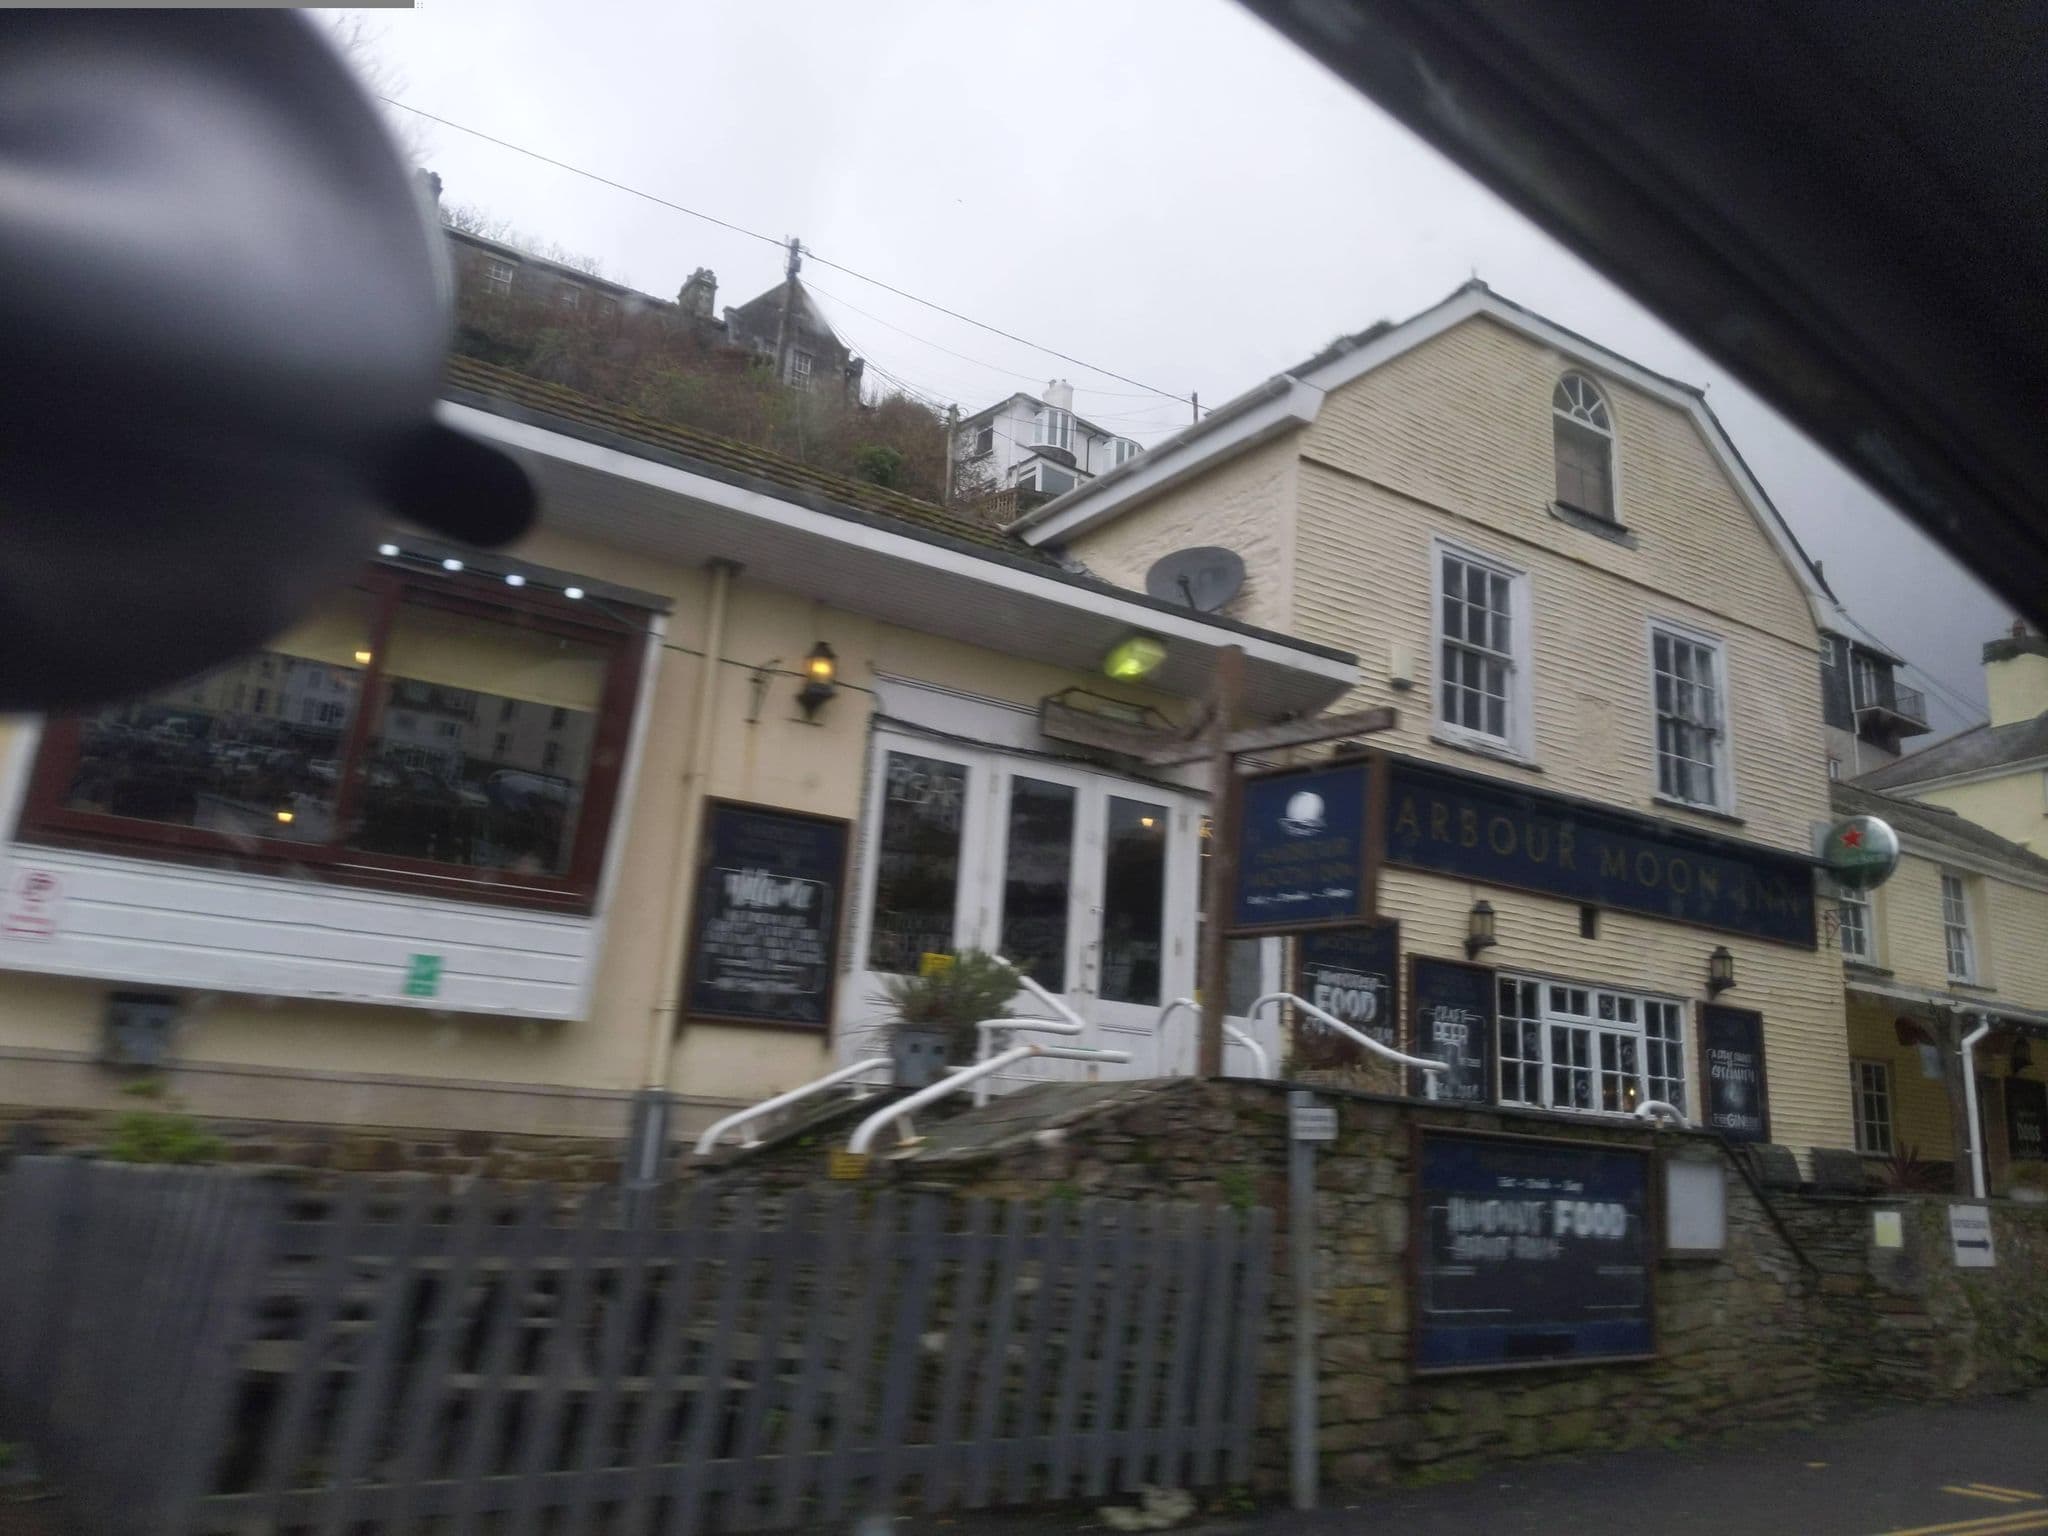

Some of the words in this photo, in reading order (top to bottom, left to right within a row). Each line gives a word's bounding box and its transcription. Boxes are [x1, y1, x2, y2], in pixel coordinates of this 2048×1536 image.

[1394, 799, 1577, 870] ARBOUR
[1601, 849, 1722, 897] MOON
[1313, 984, 1377, 1022] FOOD
[1432, 1020, 1468, 1044] BEER
[1727, 1113, 1746, 1129] GIN
[1553, 1200, 1627, 1238] FOOD
